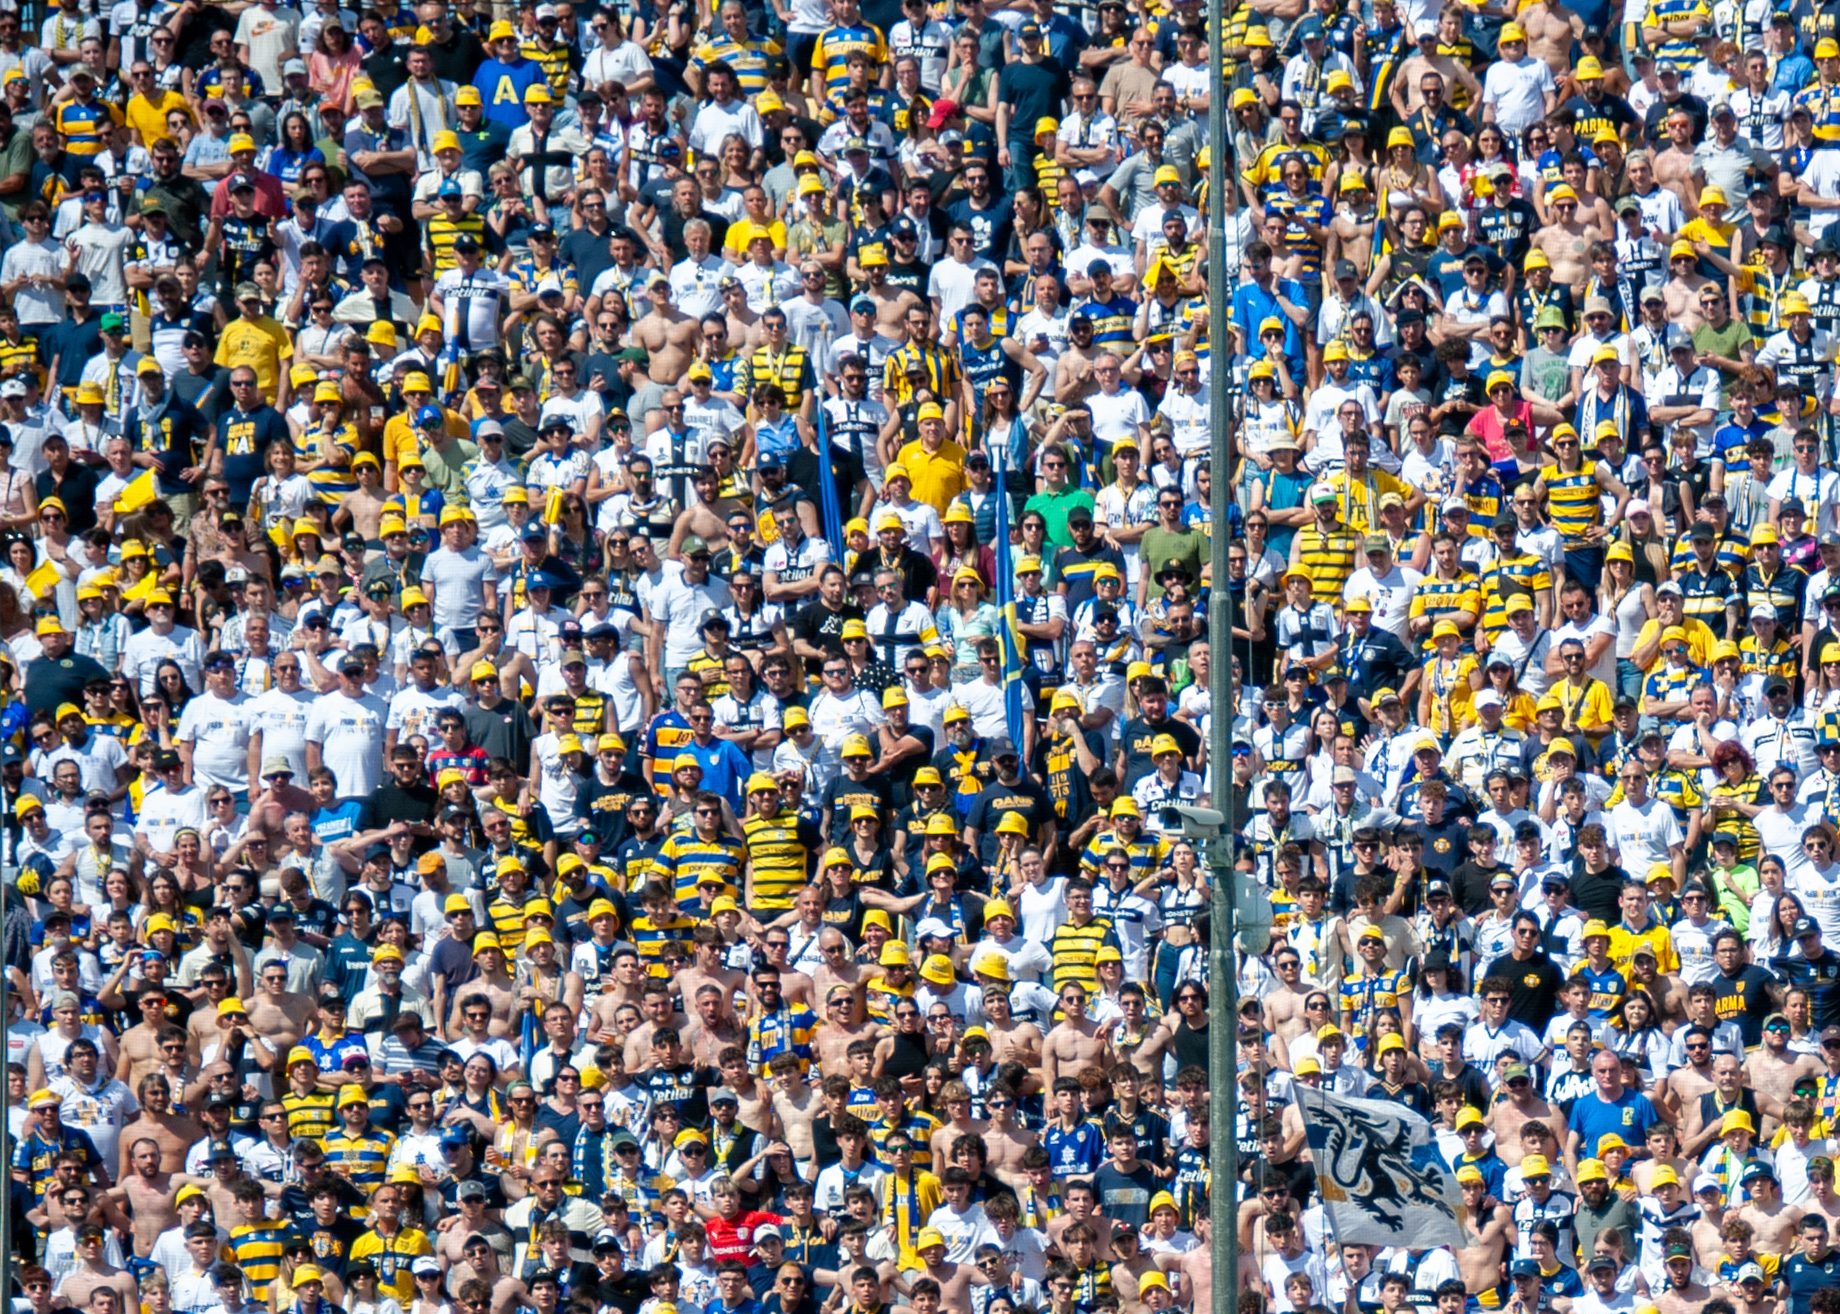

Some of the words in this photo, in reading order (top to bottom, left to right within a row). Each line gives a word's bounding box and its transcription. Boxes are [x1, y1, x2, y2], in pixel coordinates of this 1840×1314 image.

[493, 75, 519, 104] A
[1574, 119, 1614, 135] PARMA
[1715, 995, 1745, 1011] ARMA
[653, 1088, 693, 1101] Cetilar
